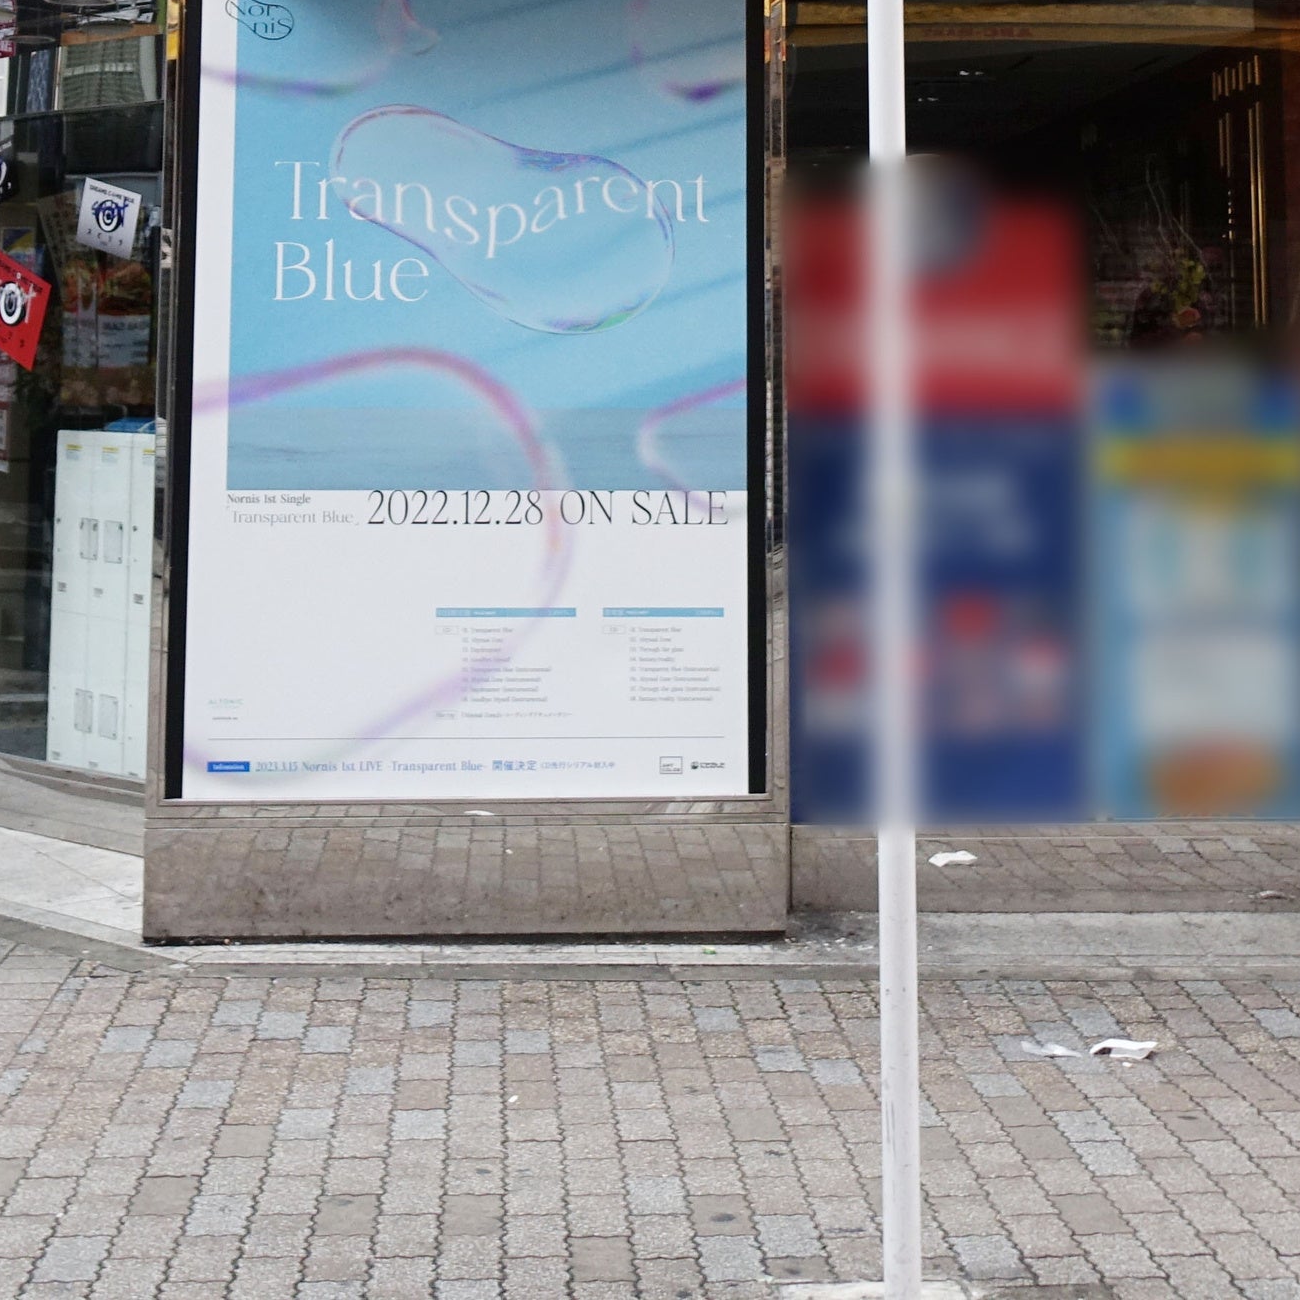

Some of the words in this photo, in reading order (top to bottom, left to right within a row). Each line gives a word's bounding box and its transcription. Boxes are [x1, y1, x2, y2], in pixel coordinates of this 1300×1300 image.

[274, 161, 709, 260] Transparent
[273, 238, 429, 302] Blue
[227, 493, 261, 504] Nornis
[280, 492, 311, 506] Single
[366, 489, 543, 526] 2022.12.28
[560, 489, 615, 526] ON
[631, 489, 730, 526] SALE
